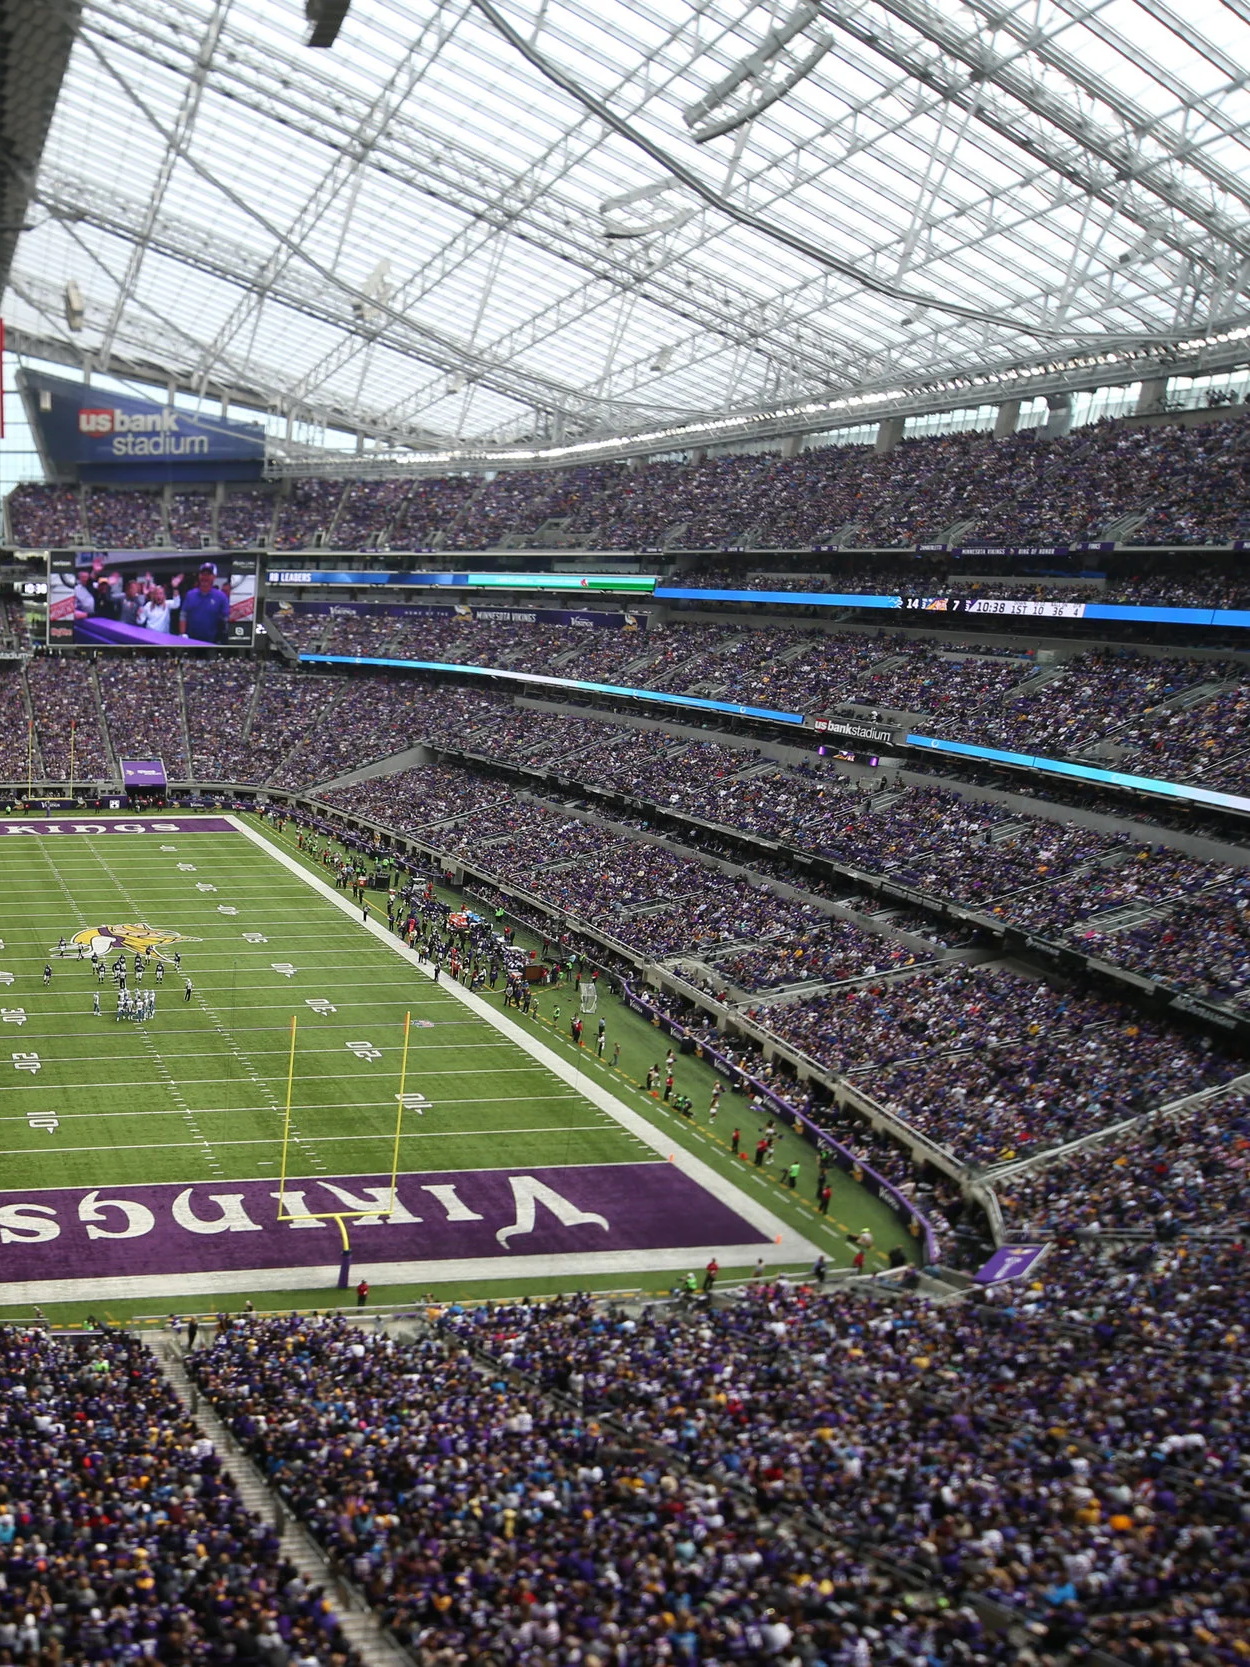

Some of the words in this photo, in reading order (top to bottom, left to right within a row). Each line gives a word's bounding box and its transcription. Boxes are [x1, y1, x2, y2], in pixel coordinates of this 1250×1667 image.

[112, 431, 208, 455] stadium
[906, 598, 919, 609] 14
[952, 600, 960, 611] 7
[976, 602, 1006, 613] 10:38
[1011, 605, 1027, 615] 1ST
[1033, 606, 1044, 616] 10
[1053, 607, 1064, 616] 36
[476, 611, 510, 621] MINNESOTA
[512, 612, 537, 623] VIKINGS
[304, 998, 338, 1013] 30
[0, 1007, 27, 1022] 30
[345, 1041, 383, 1058] 20
[11, 1052, 42, 1070] 20
[394, 1092, 433, 1109] 10
[26, 1110, 60, 1128] 10
